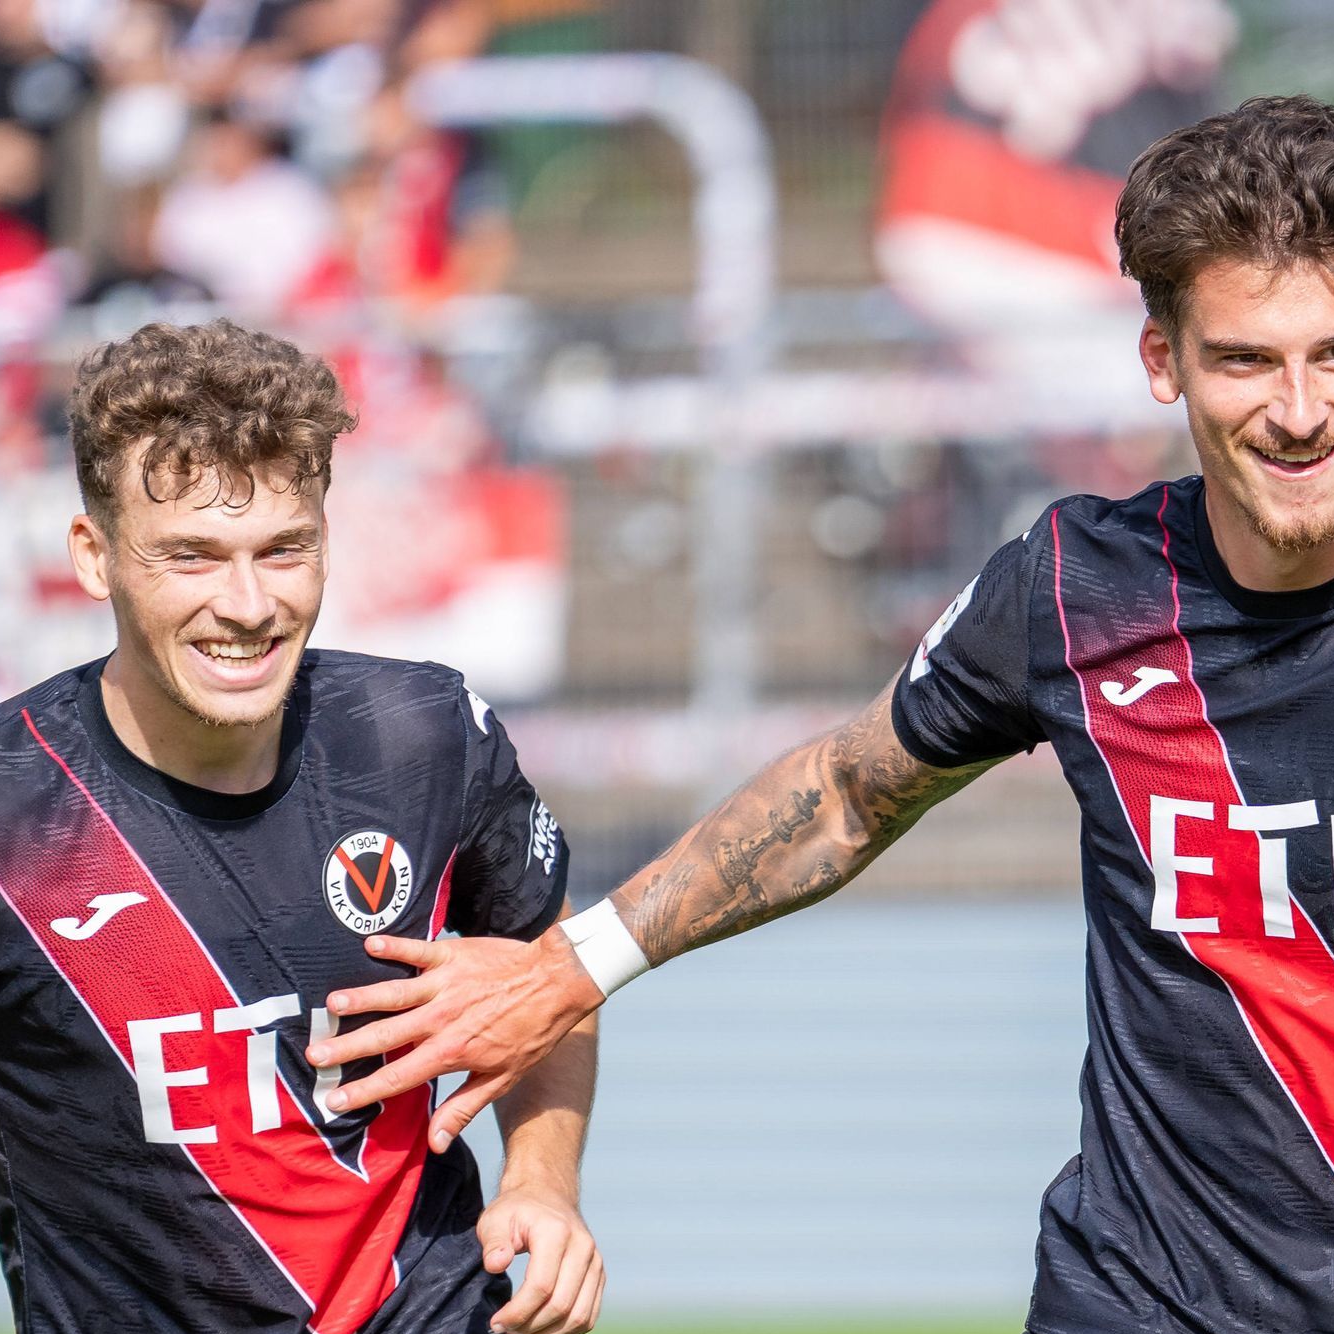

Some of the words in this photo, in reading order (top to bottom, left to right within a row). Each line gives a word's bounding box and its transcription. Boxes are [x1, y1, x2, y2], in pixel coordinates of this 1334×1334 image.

[350, 835, 378, 851] 1904
[330, 880, 386, 932] VIKTORIA
[391, 866, 409, 913] KÖLN
